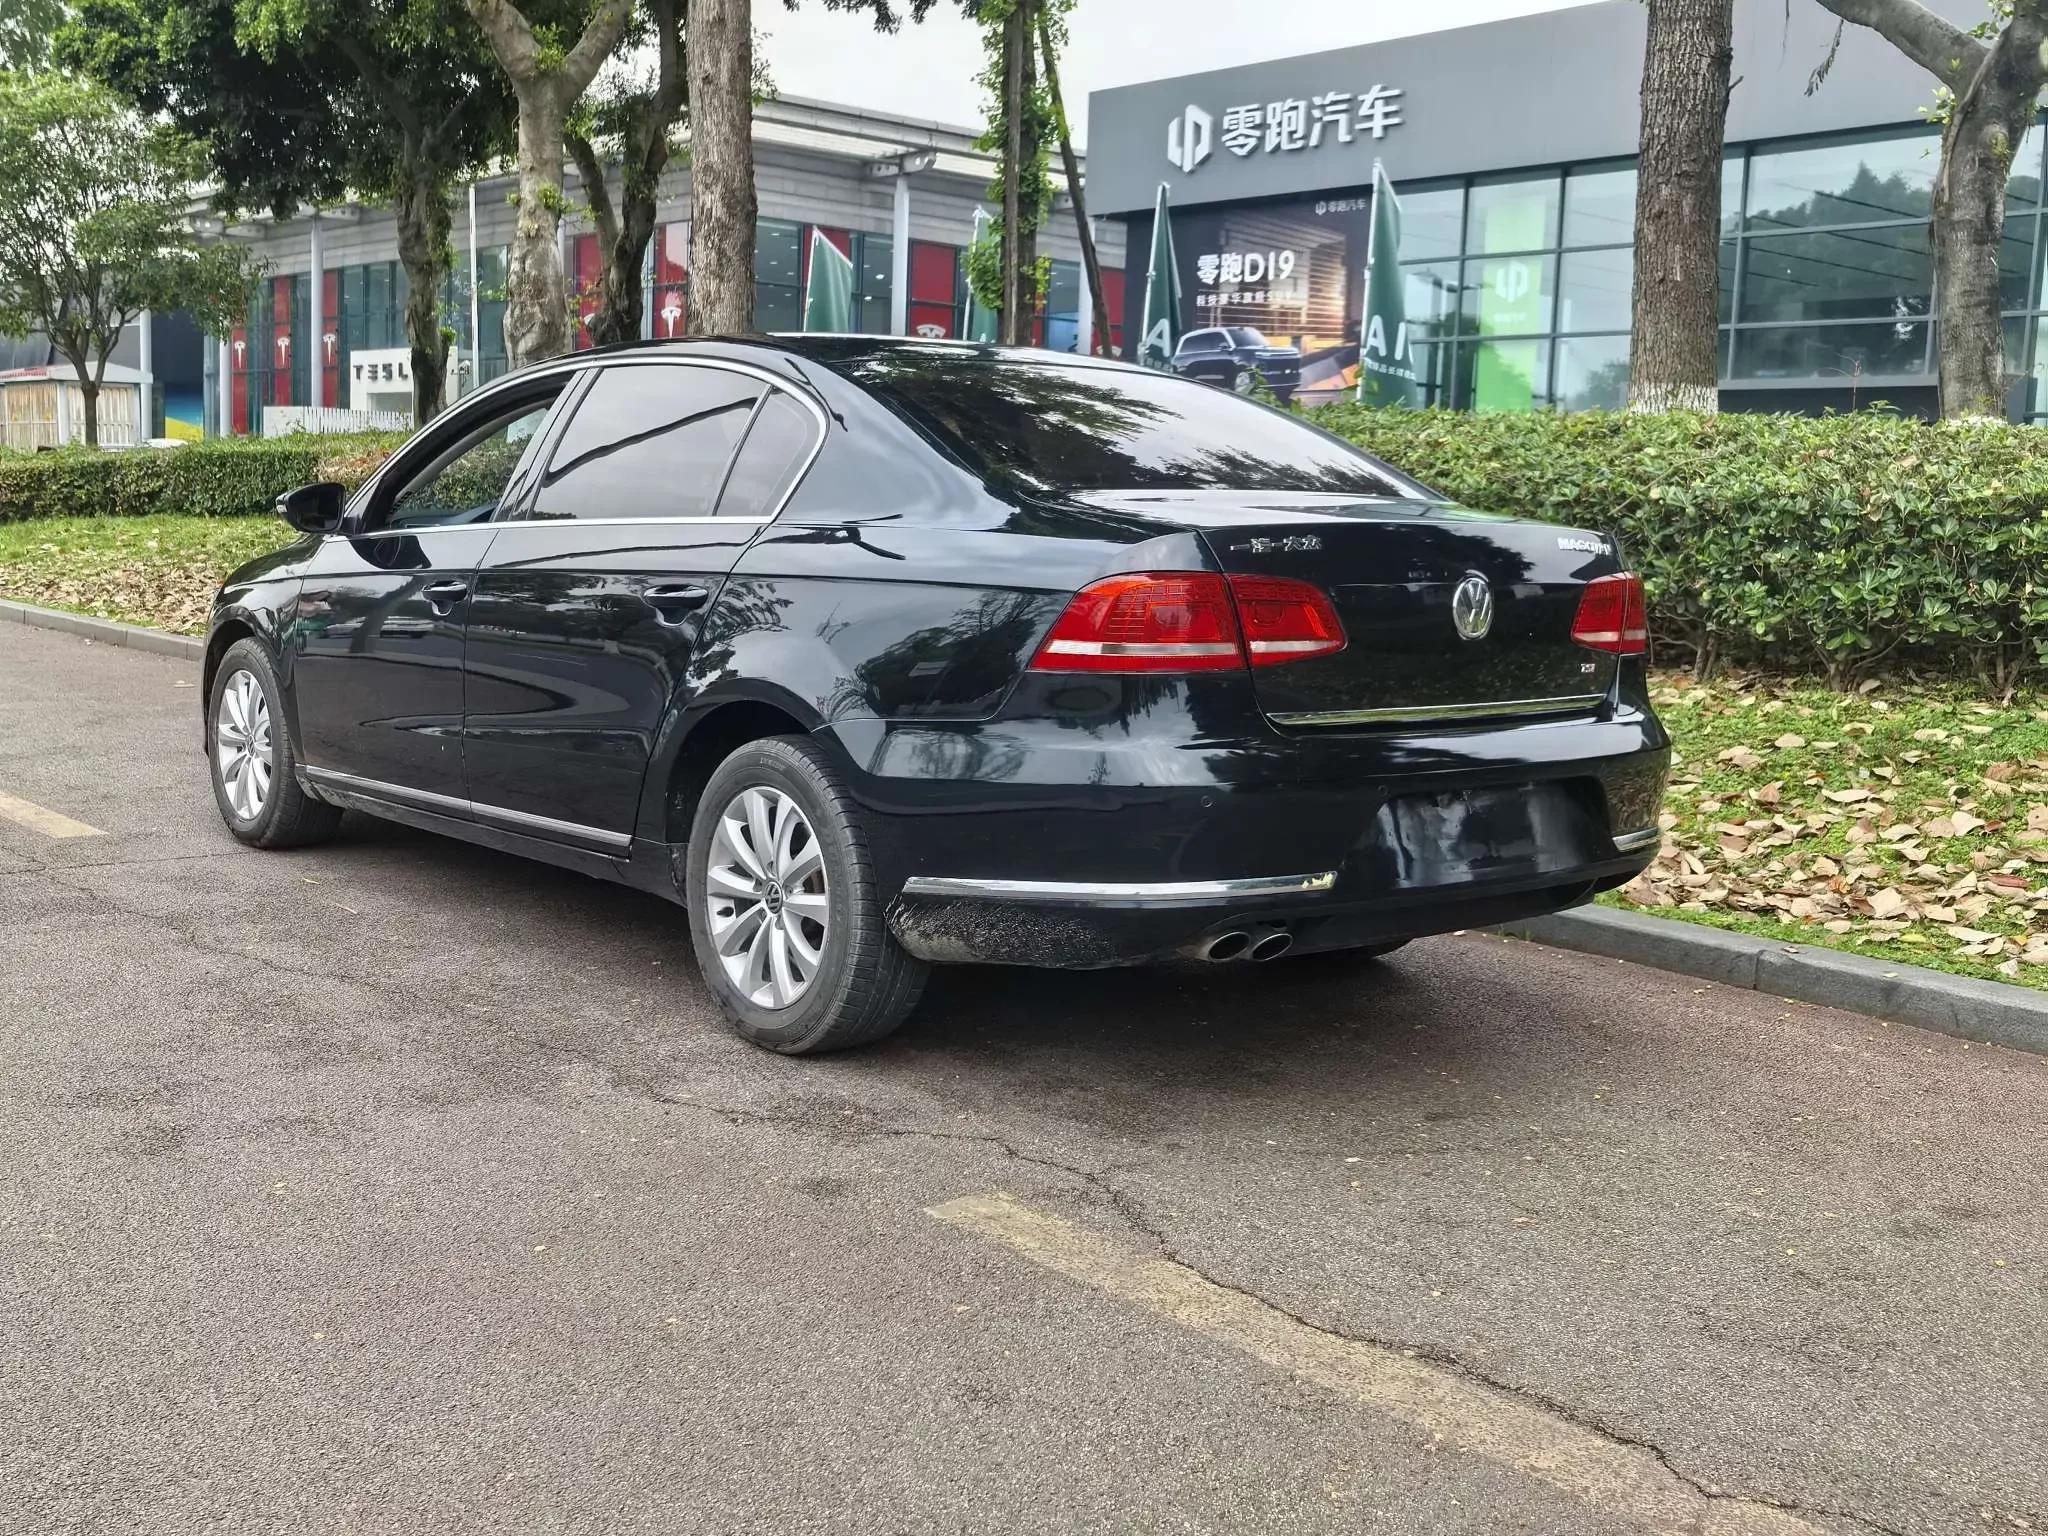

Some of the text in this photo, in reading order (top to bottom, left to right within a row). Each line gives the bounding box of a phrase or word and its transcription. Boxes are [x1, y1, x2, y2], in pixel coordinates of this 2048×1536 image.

[1222, 84, 1404, 156] 零跑汽车
[1197, 250, 1295, 285] 零跑D19
[353, 362, 409, 381] TESL
